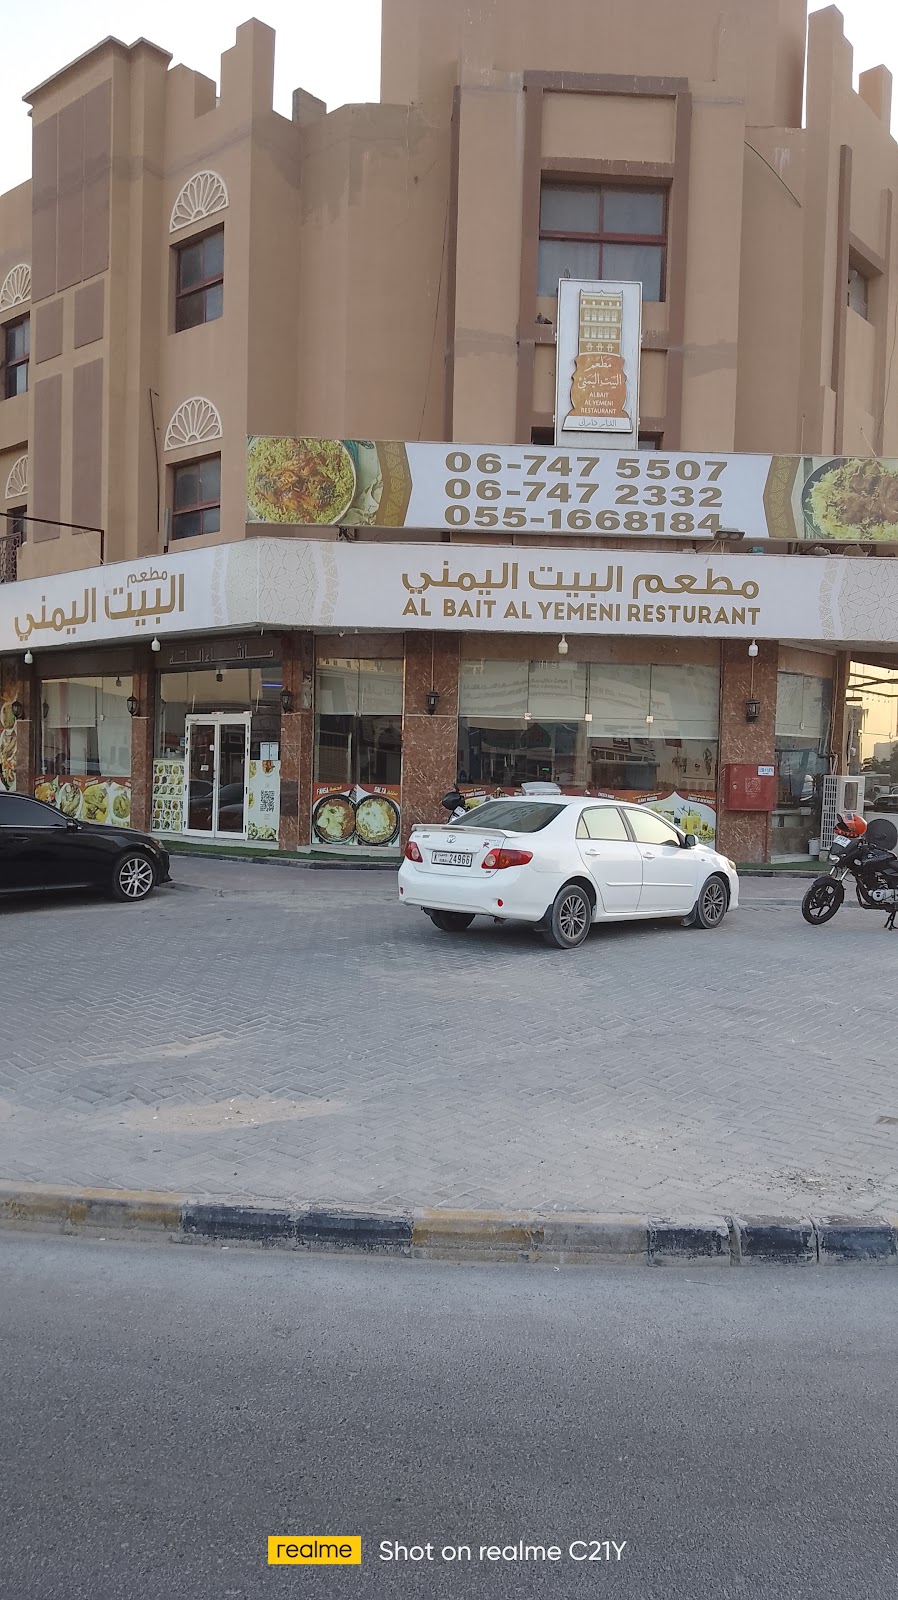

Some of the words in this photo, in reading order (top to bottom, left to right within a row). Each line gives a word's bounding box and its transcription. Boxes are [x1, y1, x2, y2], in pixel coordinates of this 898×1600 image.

[593, 399, 614, 407] YEMENI
[445, 451, 600, 477] 06-747
[615, 457, 728, 482] 5507
[444, 478, 600, 504] 06-747
[614, 484, 723, 508] 2332
[444, 504, 723, 534] 055-1668184
[127, 566, 168, 588] مطعم
[401, 560, 518, 595] اليمني
[528, 565, 623, 599] البيت
[632, 567, 760, 600] مطعم
[14, 587, 96, 641] اليمني
[104, 573, 185, 627] البيت
[402, 597, 431, 617] AL
[442, 598, 497, 618] BAIT
[503, 600, 532, 619] AL
[537, 600, 621, 622] YEMENI
[627, 603, 761, 626] RESTURANT
[448, 853, 470, 865] 24966
